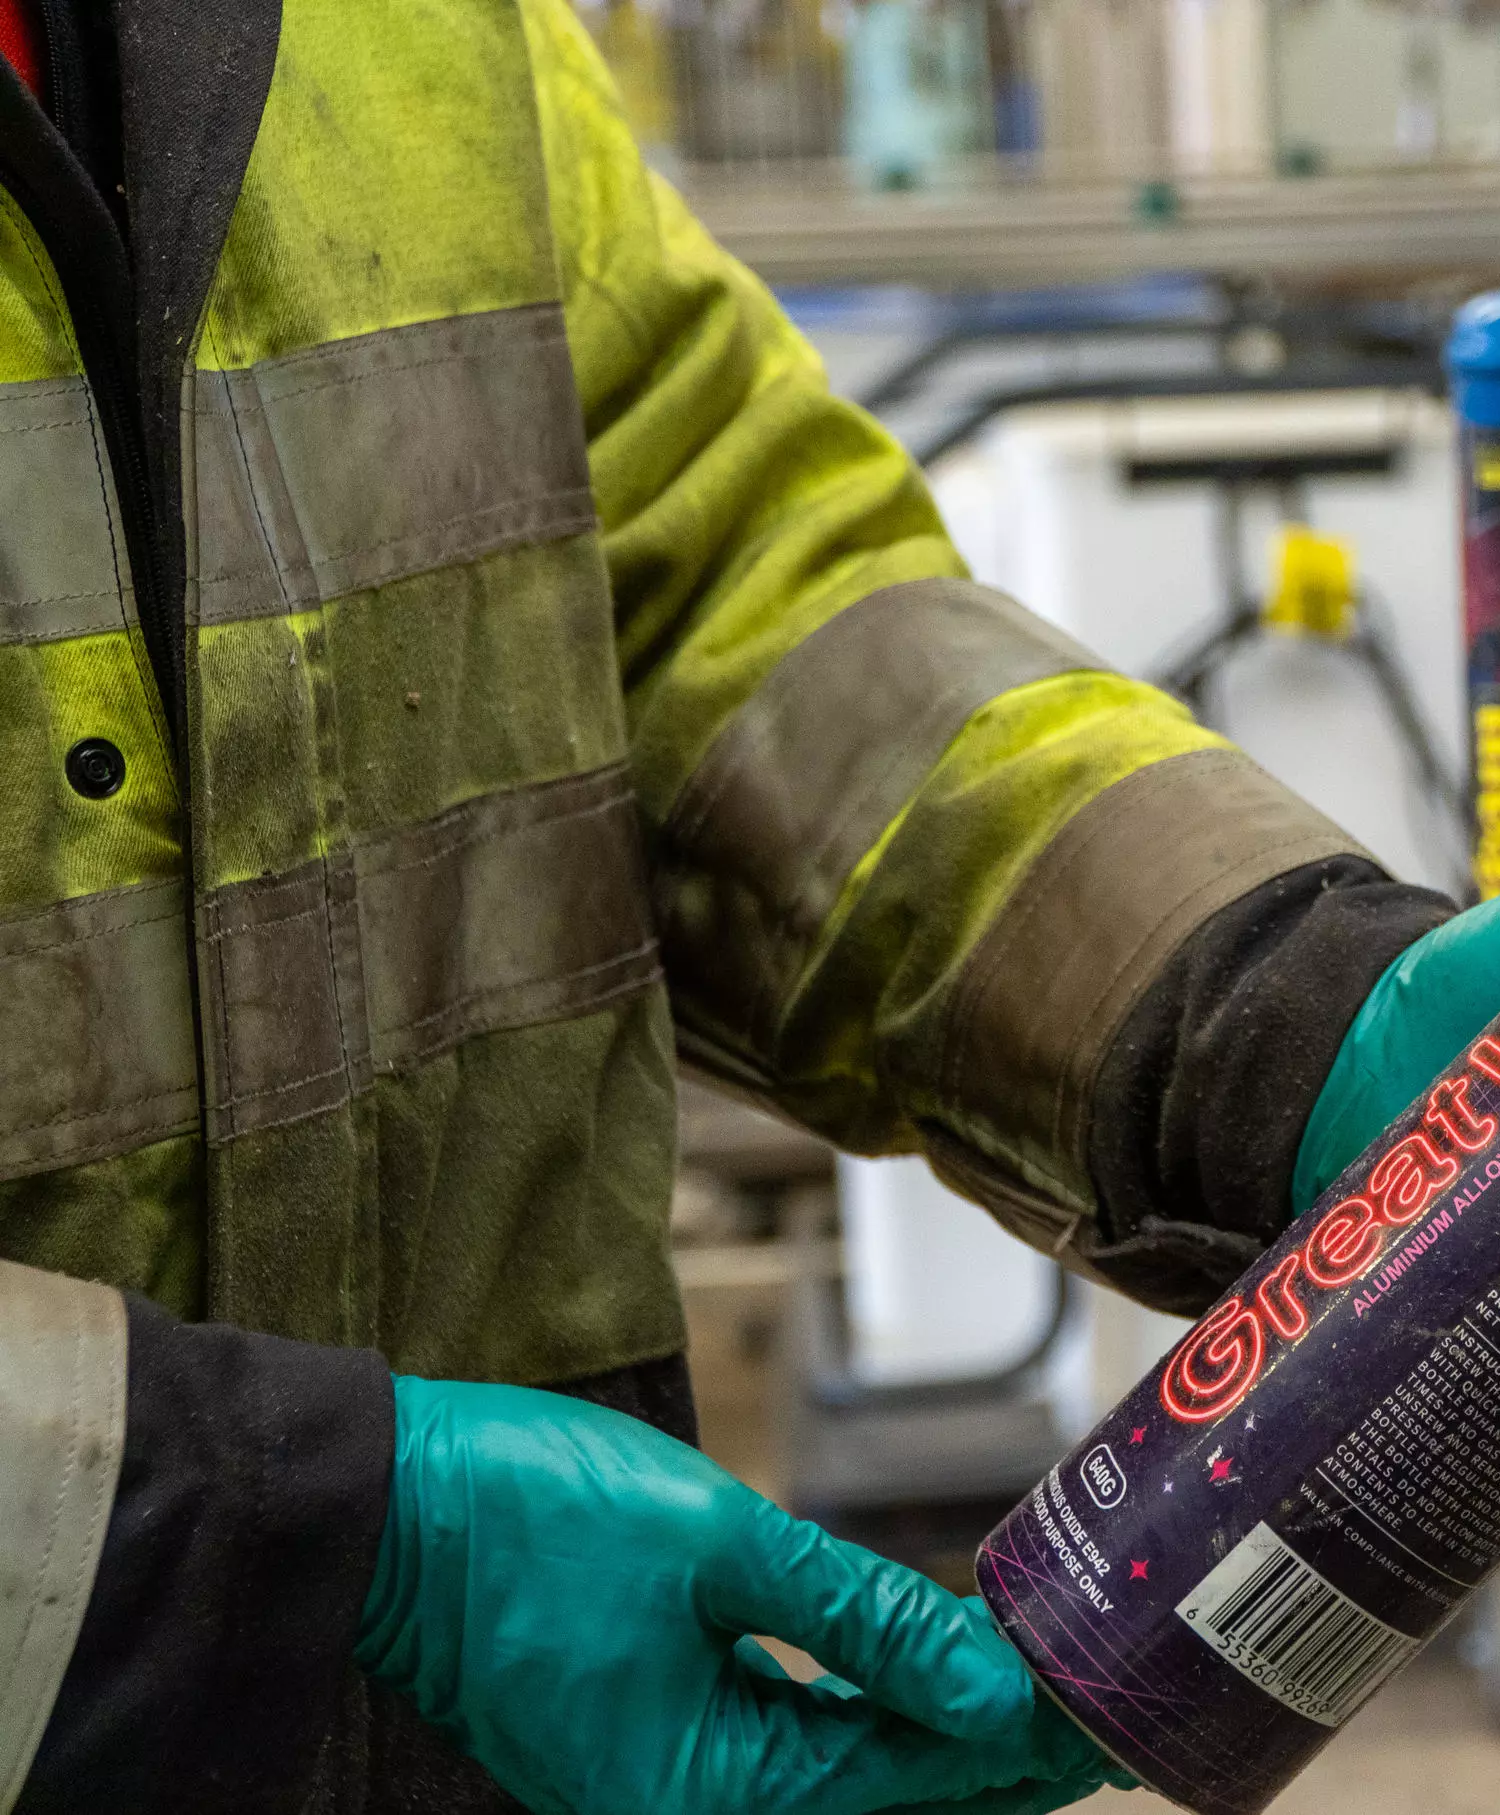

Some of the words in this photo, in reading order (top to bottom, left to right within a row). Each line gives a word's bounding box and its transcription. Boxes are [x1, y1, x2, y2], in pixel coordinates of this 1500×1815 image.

[1354, 1208, 1453, 1317] ALUMINIUM
[1474, 1301, 1500, 1328] NET
[1416, 1360, 1465, 1407] BOTTLE
[1428, 1348, 1463, 1382] WITH
[1461, 1378, 1500, 1417] QUICK
[1439, 1336, 1484, 1379] SCREW
[1369, 1407, 1418, 1455] BOTTLE
[1416, 1451, 1433, 1468] IS
[1431, 1464, 1470, 1499] EMPTY
[1381, 1395, 1445, 1456] PRESSURE
[1393, 1384, 1445, 1434] UNSREW
[1443, 1430, 1471, 1457] AND
[1456, 1420, 1478, 1441] NO
[1475, 1436, 1500, 1461] GAS
[1088, 1456, 1118, 1497] 640G
[1322, 1454, 1405, 1533] ATMOSPHERE.
[1334, 1443, 1399, 1506] CONTENTS
[1398, 1502, 1417, 1520] TO
[1415, 1516, 1445, 1543] LEAK
[1443, 1537, 1458, 1550] IN
[1456, 1545, 1471, 1558] TO
[1346, 1431, 1397, 1482] METALS.
[1396, 1478, 1416, 1498] DO
[1415, 1494, 1442, 1519] NOT
[1439, 1514, 1476, 1543] ALLOW
[1357, 1419, 1386, 1447] THE
[1384, 1443, 1432, 1487] BOTTLE
[1430, 1483, 1462, 1511] WITH
[1459, 1506, 1493, 1534] OTHER
[1032, 1491, 1049, 1520] FOOD
[1041, 1517, 1082, 1578] PURPOSE
[1076, 1573, 1113, 1612] ONLY
[1058, 1505, 1087, 1545] OXIDE
[1080, 1541, 1111, 1577] E942
[1297, 1483, 1330, 1515] VALVE
[1342, 1525, 1405, 1578] COMPLIANCE
[1188, 1608, 1196, 1618] 6
[1218, 1633, 1279, 1685] 55360
